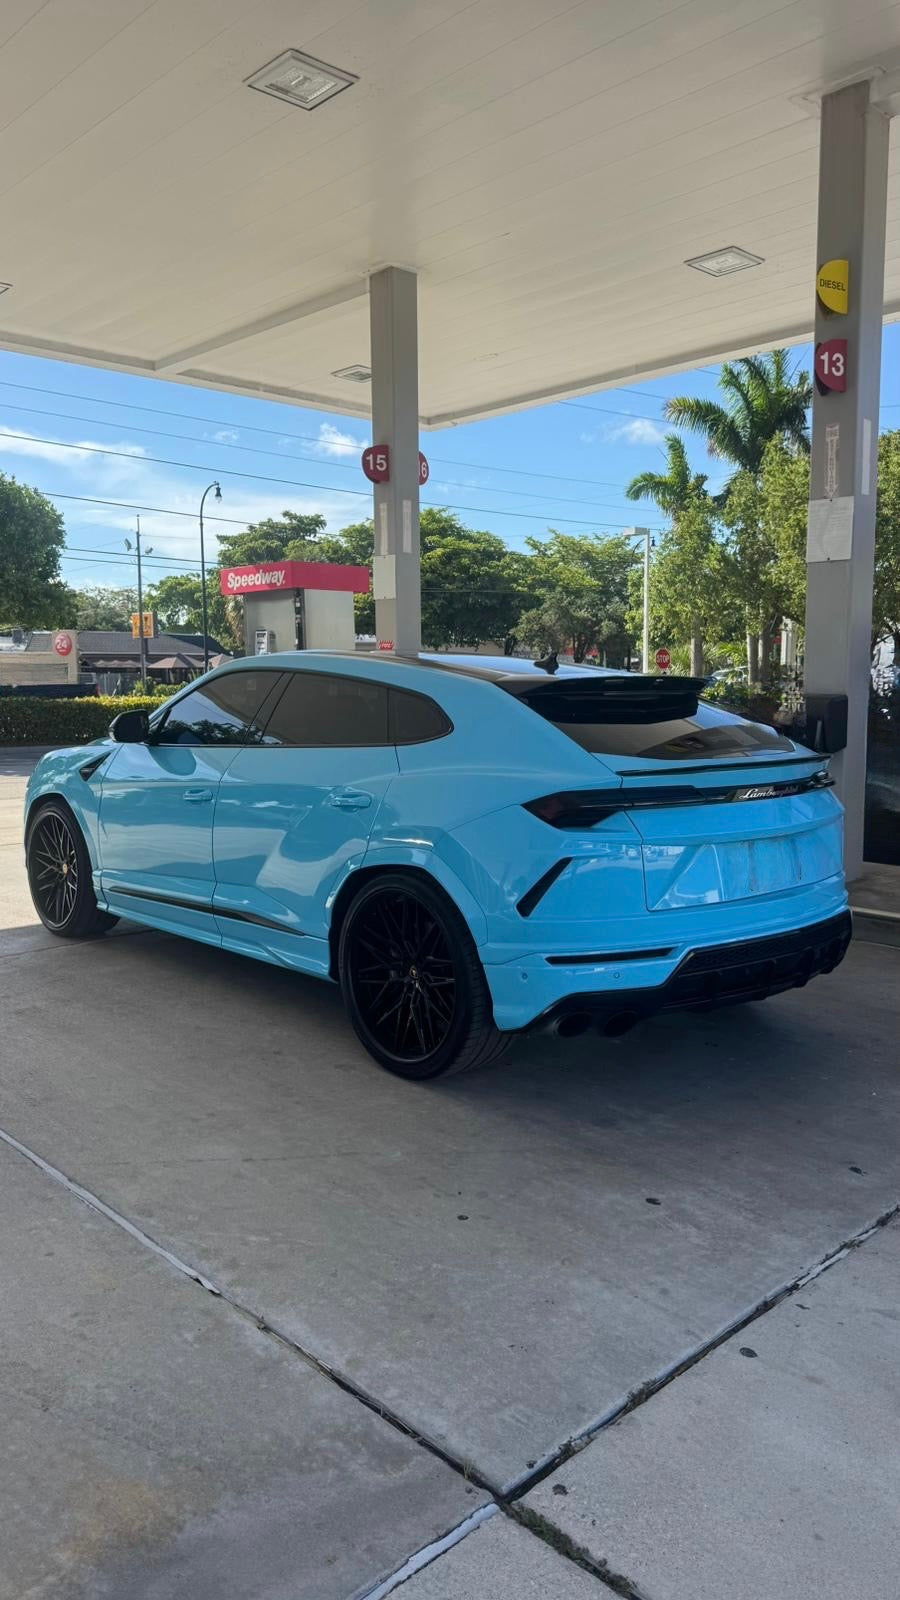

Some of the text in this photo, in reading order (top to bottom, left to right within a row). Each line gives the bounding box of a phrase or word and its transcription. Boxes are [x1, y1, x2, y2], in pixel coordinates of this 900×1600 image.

[819, 278, 846, 291] DIESEL
[820, 352, 845, 376] 13
[366, 454, 387, 471] 15
[419, 460, 427, 478] 6
[227, 569, 285, 591] Speedway
[656, 654, 670, 663] STOP
